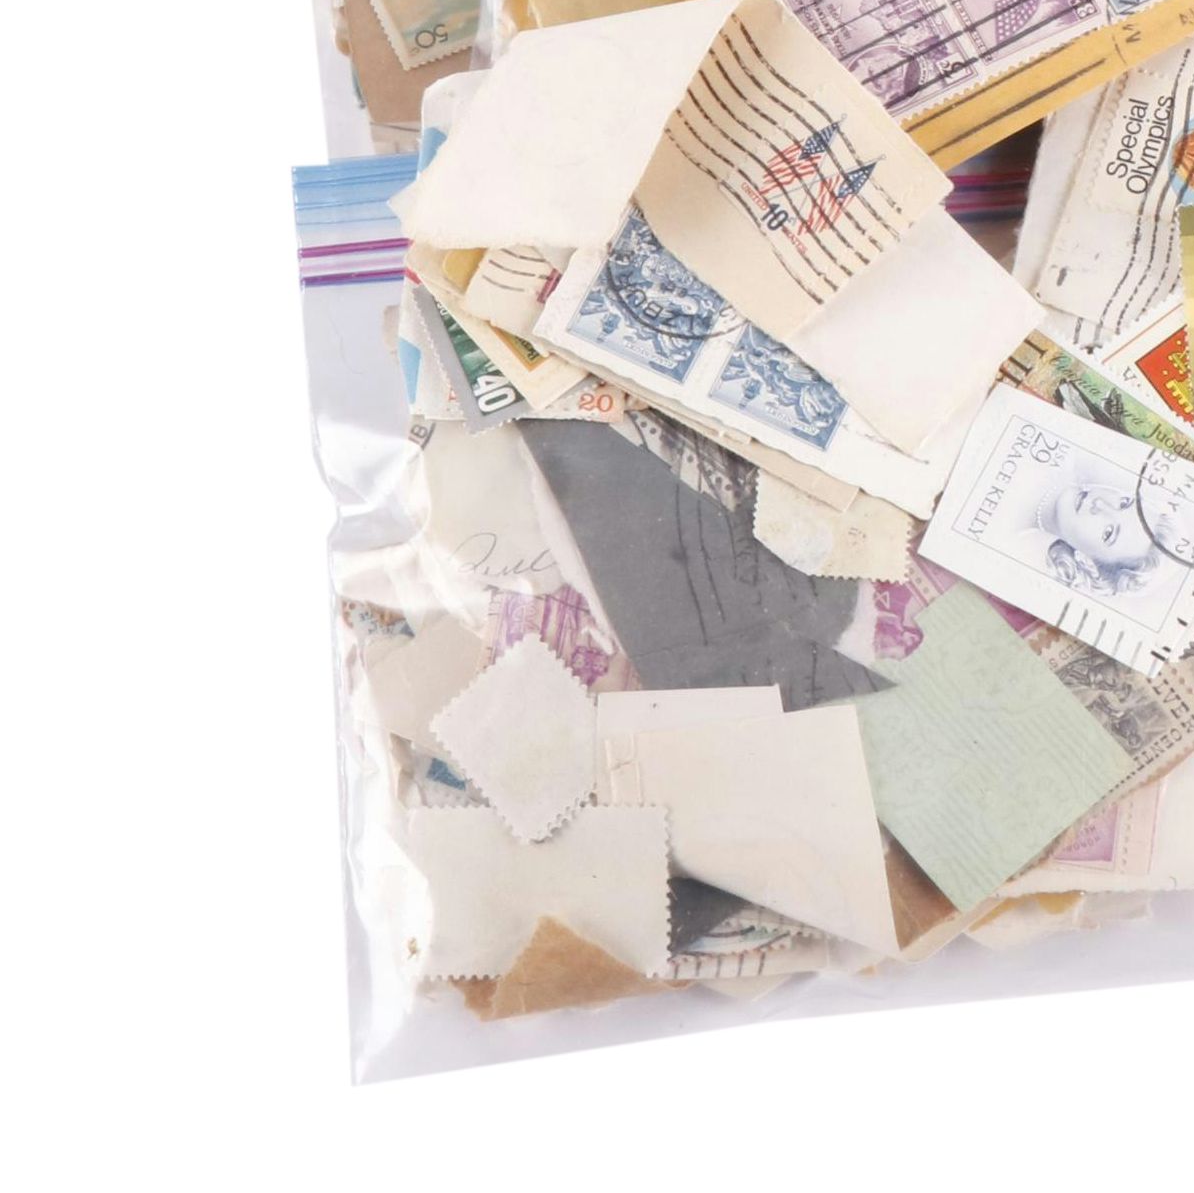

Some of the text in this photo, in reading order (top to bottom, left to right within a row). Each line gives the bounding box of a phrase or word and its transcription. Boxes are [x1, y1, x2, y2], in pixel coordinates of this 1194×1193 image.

[1106, 98, 1150, 179] Special
[1125, 94, 1174, 196] Olympics
[740, 180, 769, 212] UNITED
[473, 373, 518, 414] 40
[578, 393, 616, 413] 20
[1029, 430, 1061, 465] 29
[1048, 442, 1071, 470] USA
[966, 422, 1035, 542] GRACE KELLY
